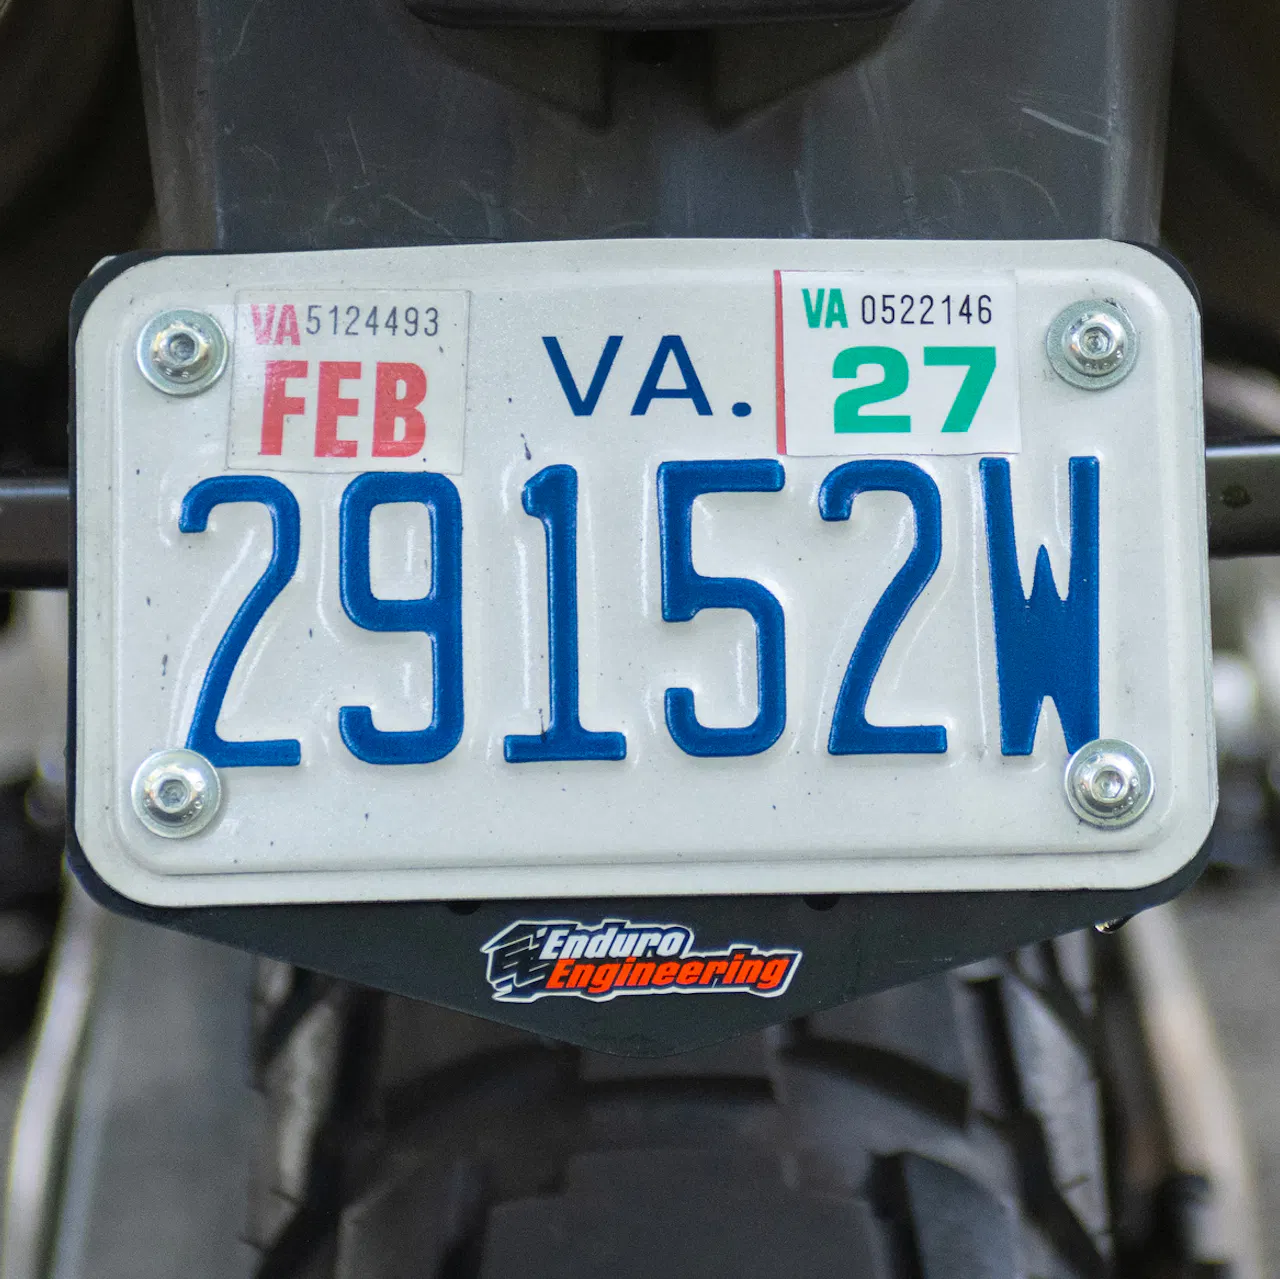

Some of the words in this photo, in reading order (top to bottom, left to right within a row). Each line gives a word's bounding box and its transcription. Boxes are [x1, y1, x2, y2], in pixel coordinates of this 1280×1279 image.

[250, 303, 301, 346] VA
[306, 305, 439, 337] 5124493
[801, 288, 849, 328] VA
[861, 294, 993, 325] 0522146
[542, 335, 752, 418] VA.
[832, 345, 997, 434] 27
[260, 359, 428, 458] FEB
[178, 455, 1100, 768] 29152W
[538, 923, 686, 960] Enduro
[544, 952, 791, 993] Engineering
